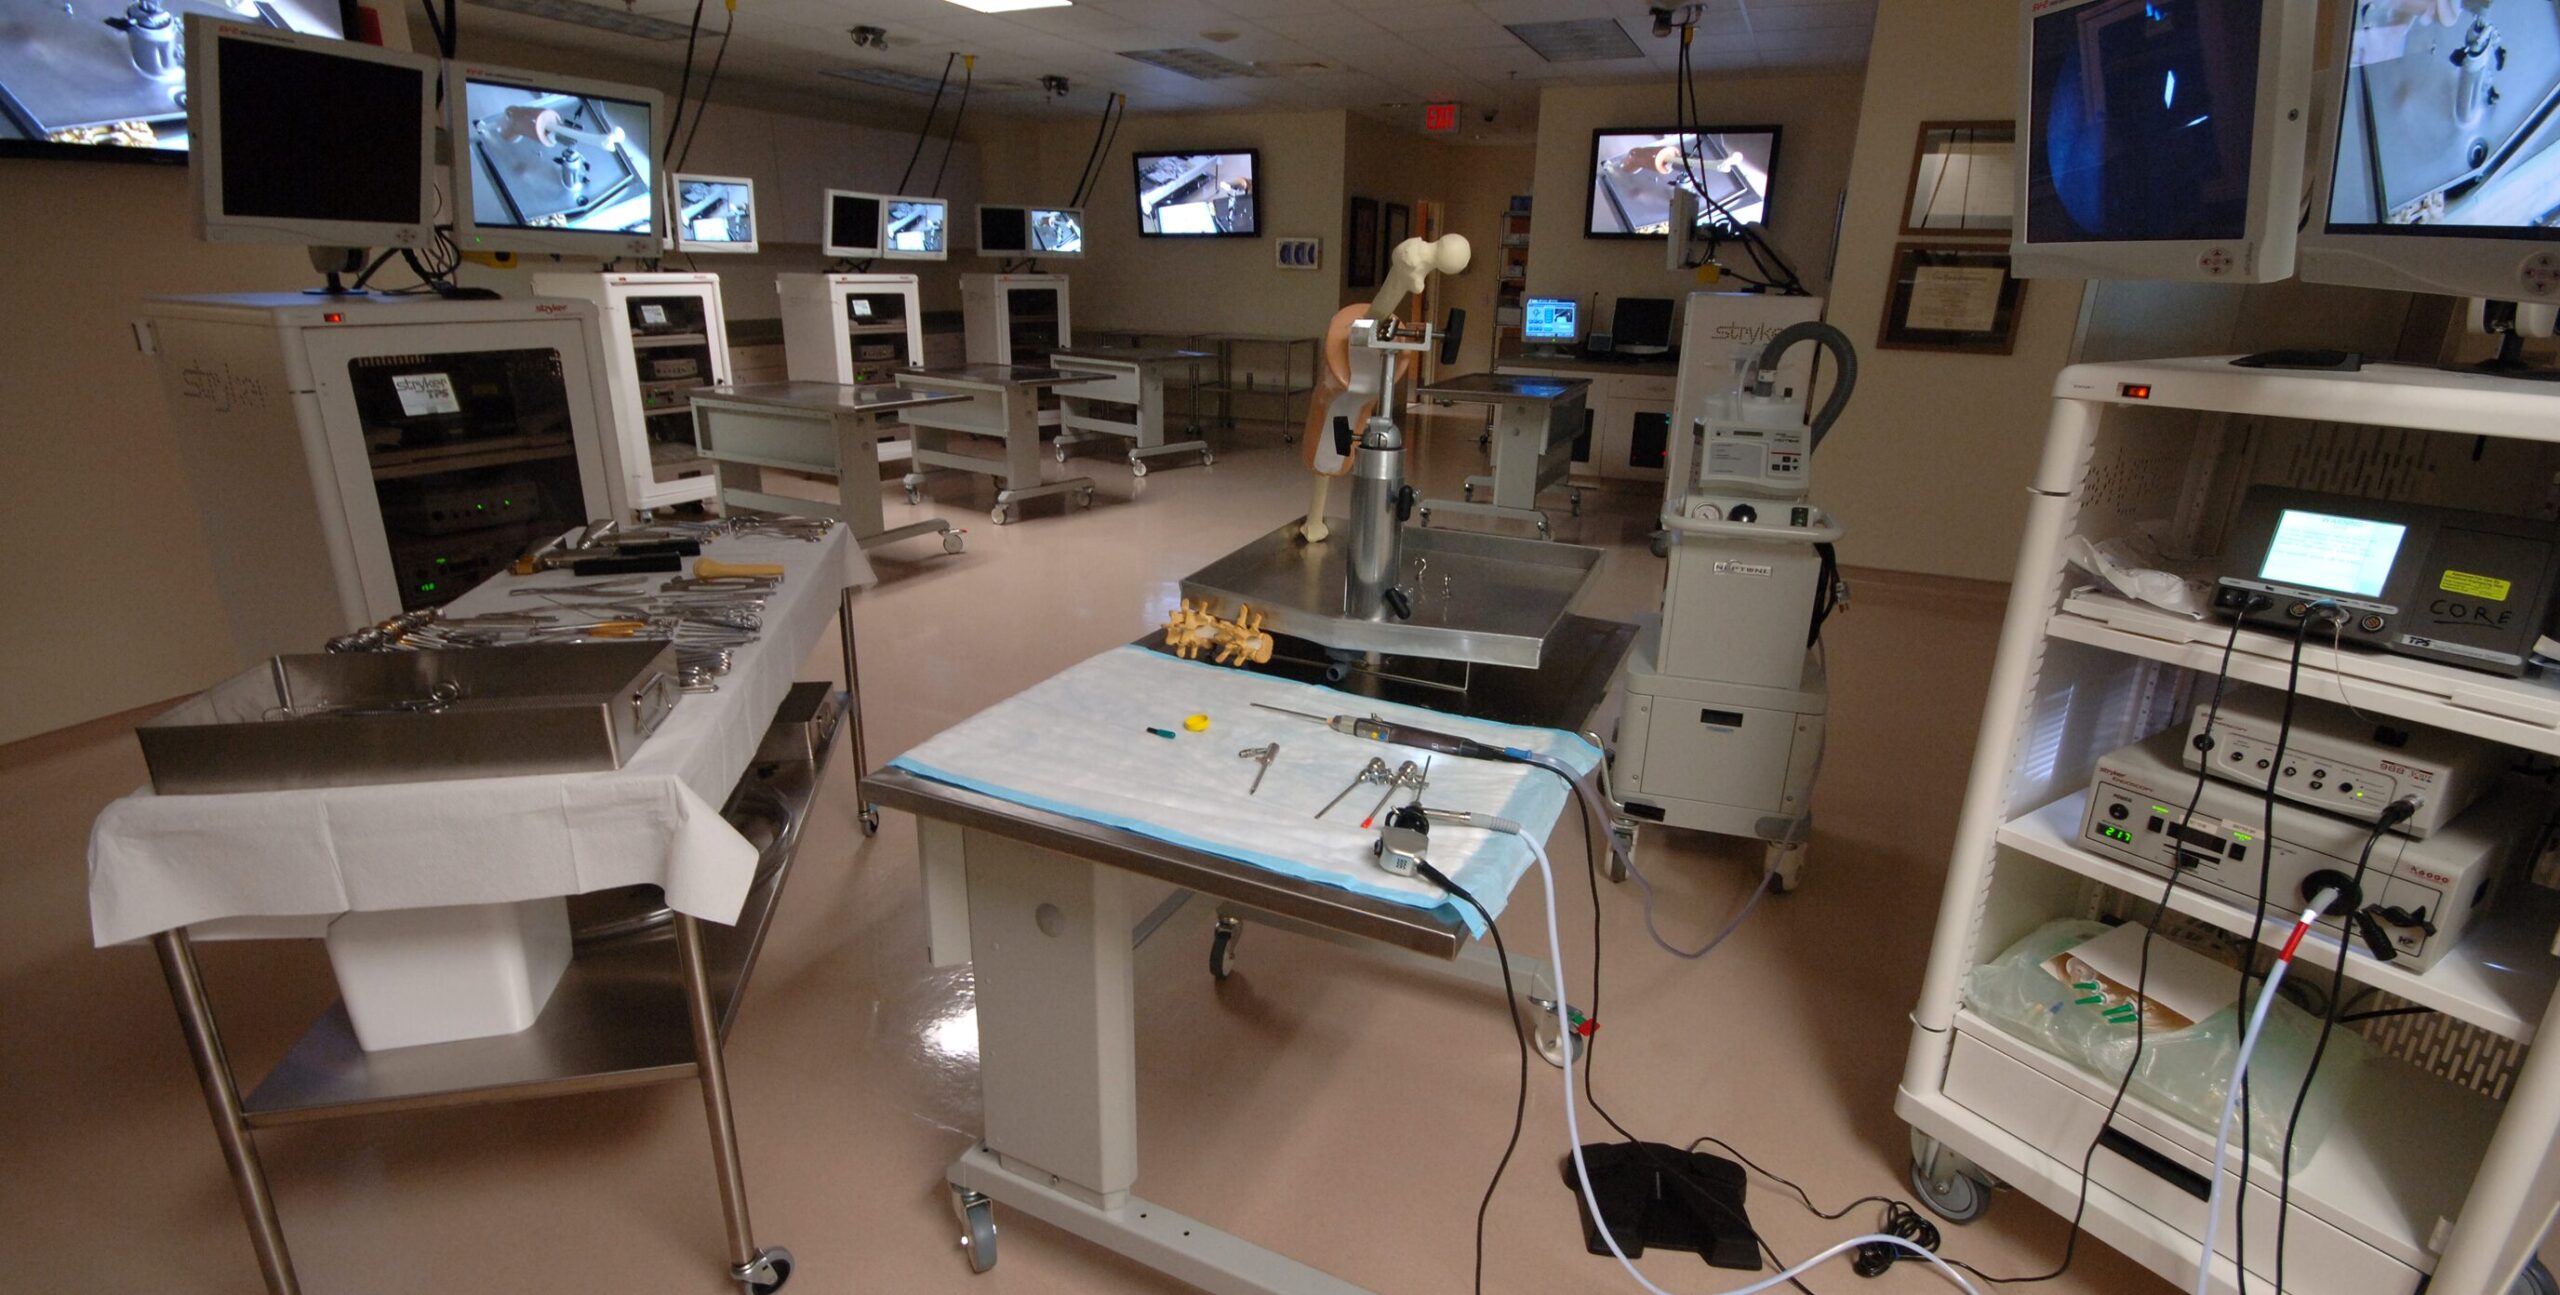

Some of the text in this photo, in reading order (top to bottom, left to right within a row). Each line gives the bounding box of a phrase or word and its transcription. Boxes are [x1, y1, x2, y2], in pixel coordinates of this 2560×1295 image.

[1426, 105, 1456, 129] EXIT
[396, 376, 448, 393] stryker
[2430, 600, 2513, 625] CORE
[2409, 636, 2431, 647] TPS
[2380, 763, 2405, 775] 988
[2104, 826, 2132, 842] 217
